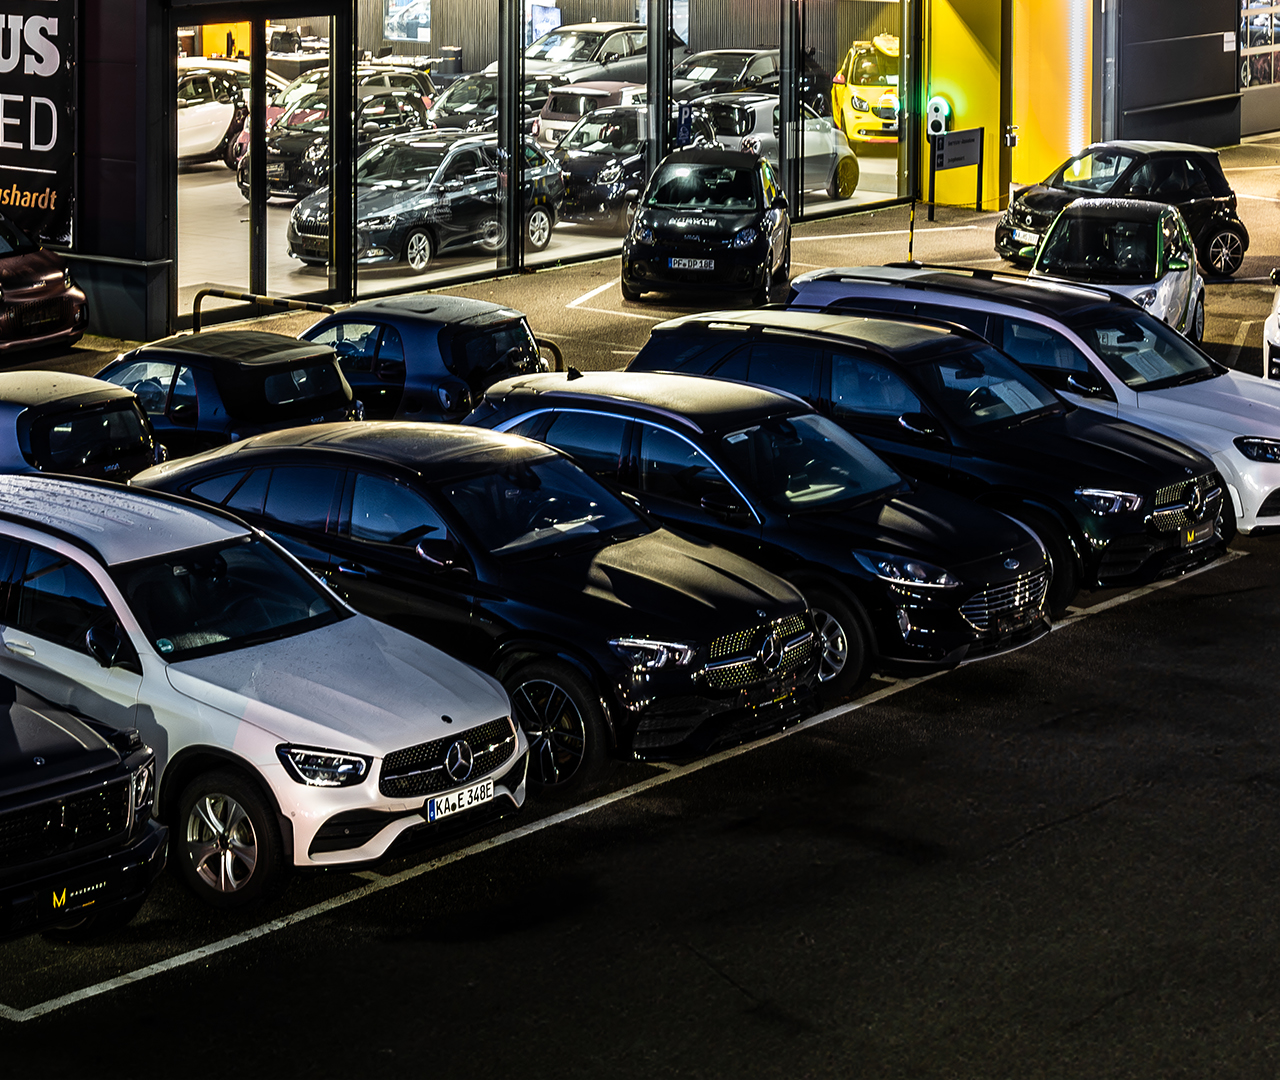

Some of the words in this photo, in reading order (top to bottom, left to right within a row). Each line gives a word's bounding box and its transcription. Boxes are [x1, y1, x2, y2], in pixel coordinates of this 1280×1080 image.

[682, 107, 690, 125] P
[435, 796, 451, 817] KA
[457, 791, 465, 809] E
[467, 781, 493, 806] 348E
